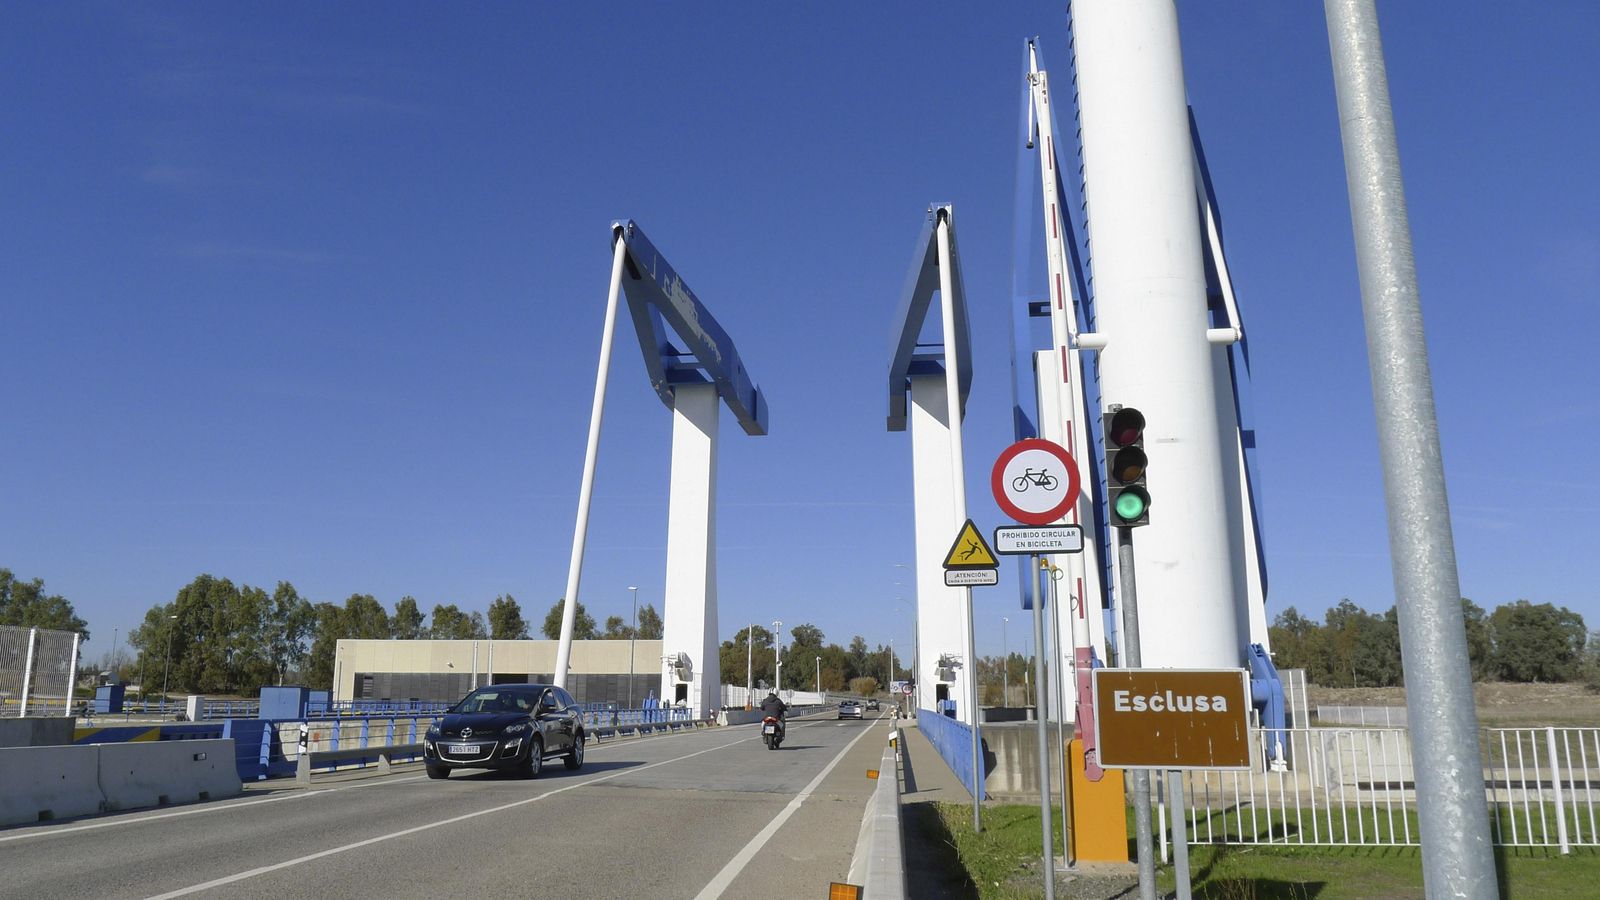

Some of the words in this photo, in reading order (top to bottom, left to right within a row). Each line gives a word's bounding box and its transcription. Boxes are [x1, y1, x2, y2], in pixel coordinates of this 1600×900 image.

[1001, 531, 1040, 539] PROHIBIDO
[1041, 530, 1076, 538] CIRCULAR
[1027, 540, 1063, 548] BICICLETA
[1113, 690, 1228, 713] Esclusa
